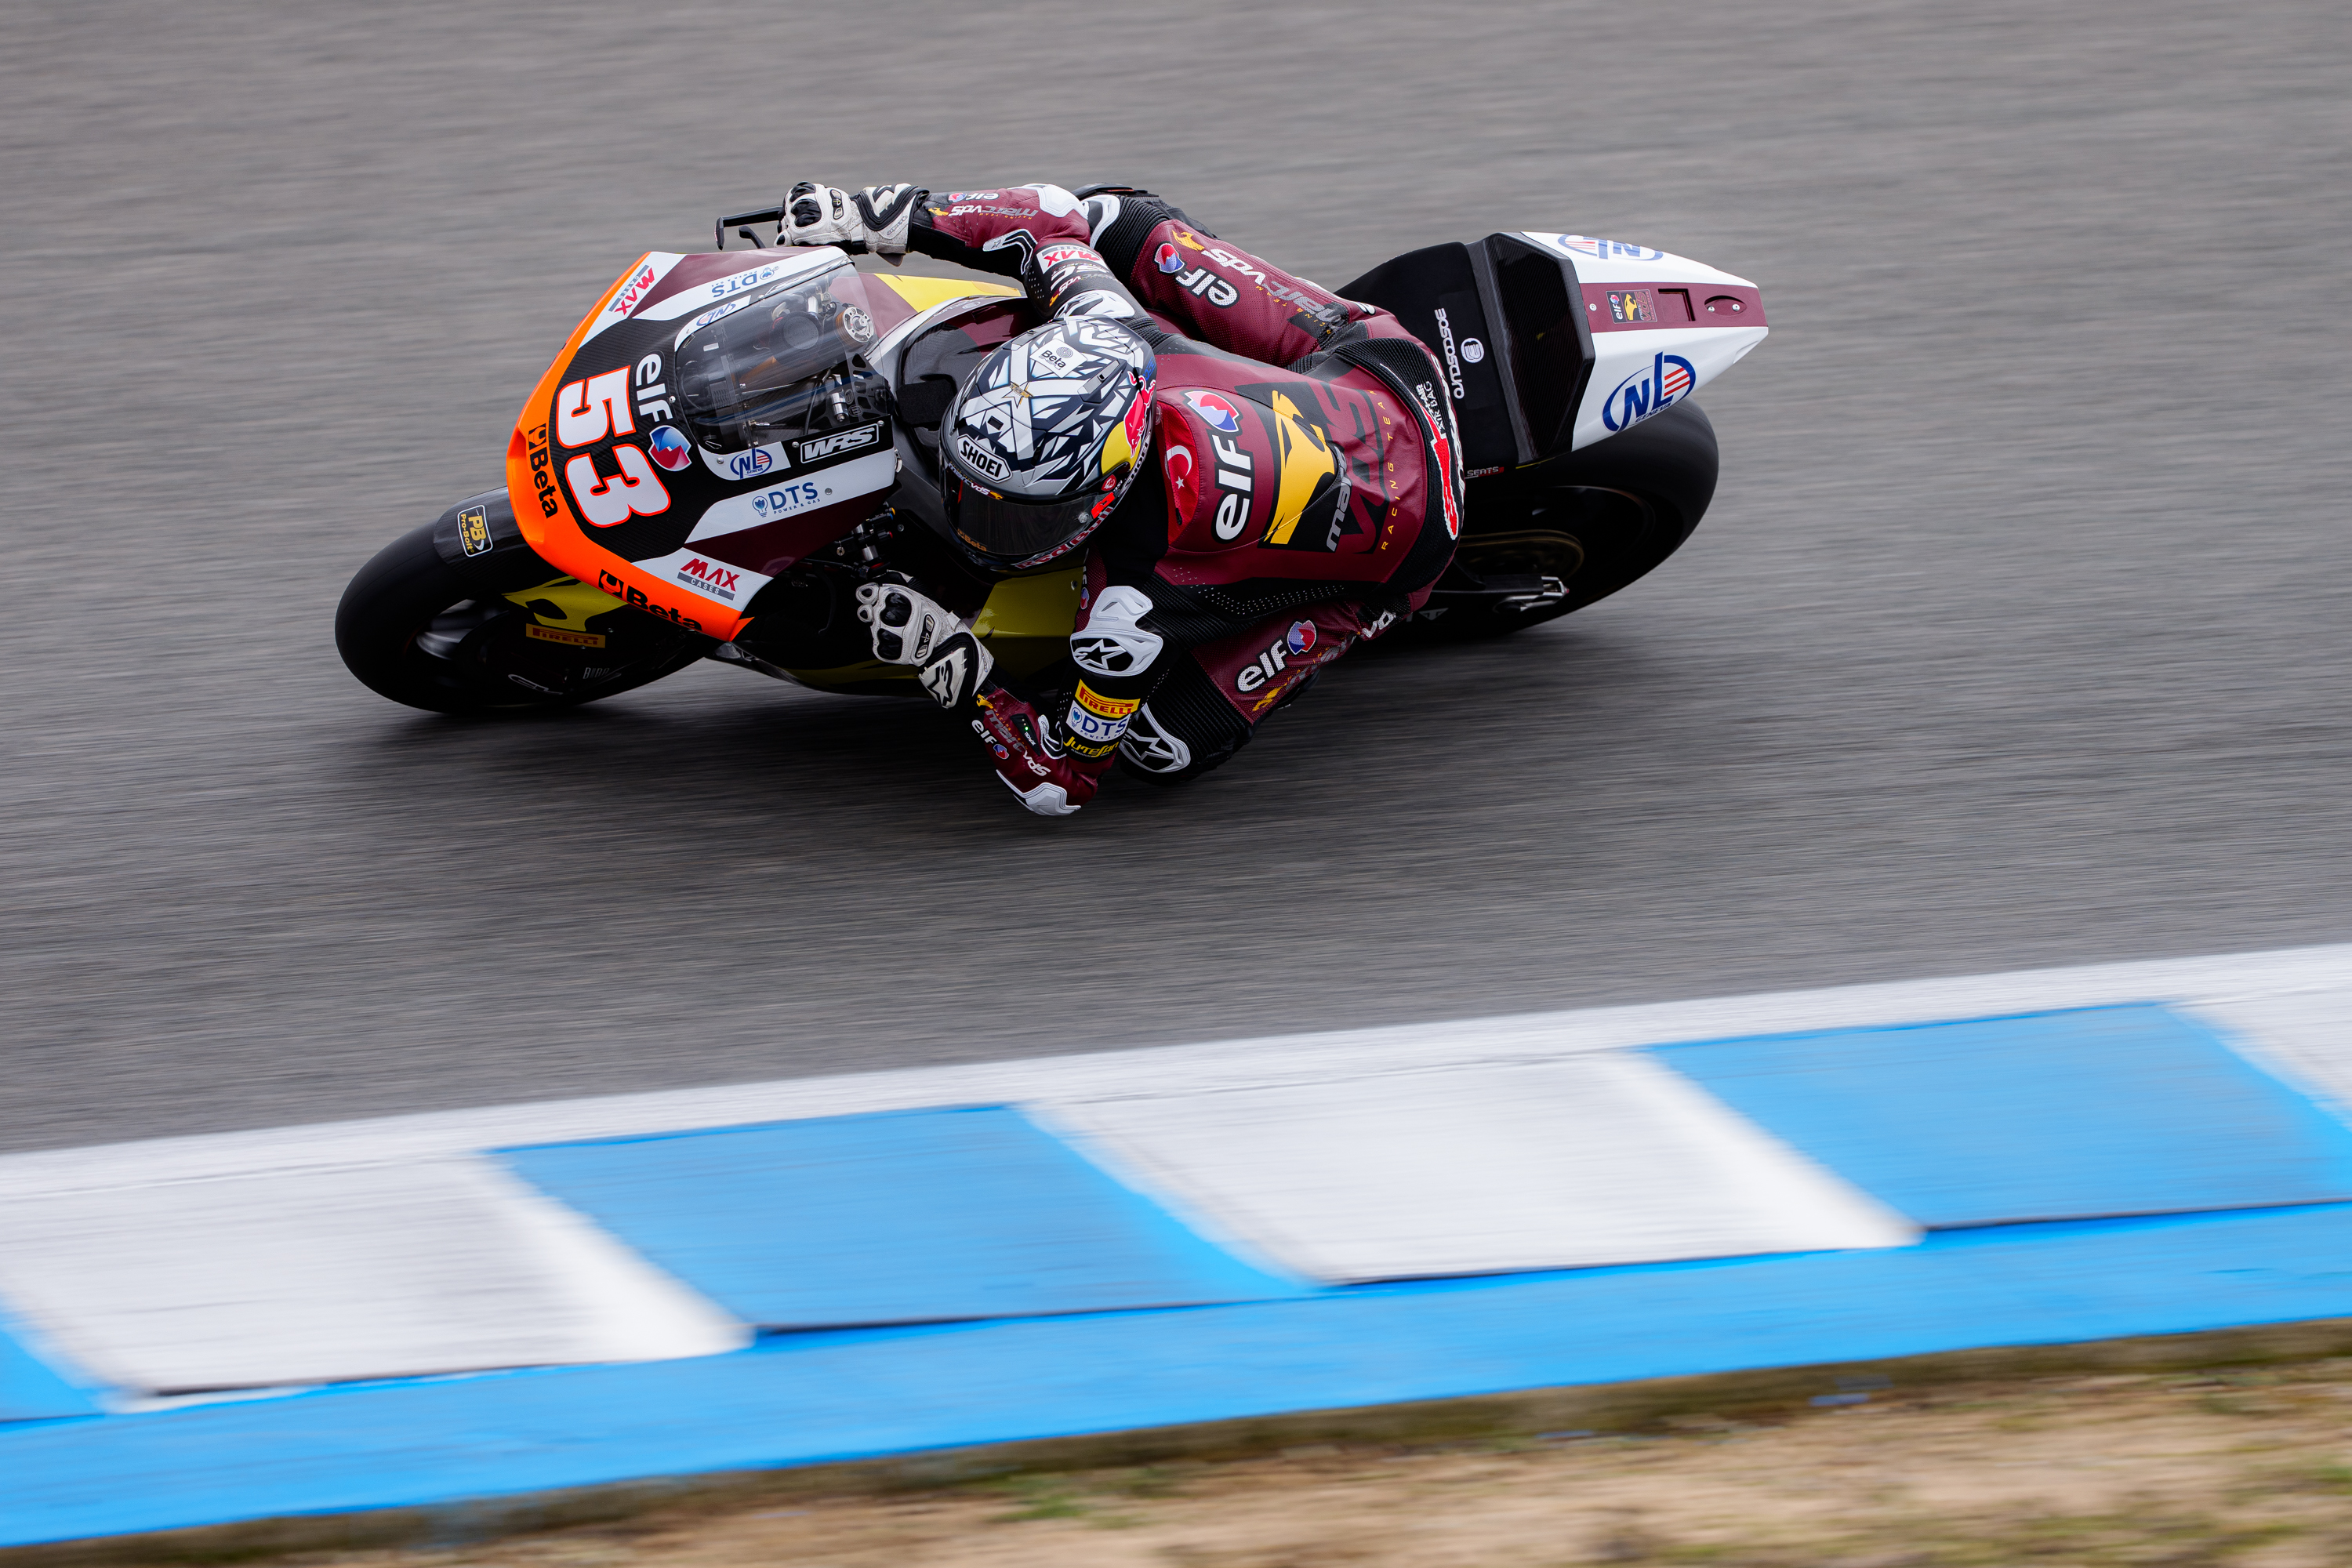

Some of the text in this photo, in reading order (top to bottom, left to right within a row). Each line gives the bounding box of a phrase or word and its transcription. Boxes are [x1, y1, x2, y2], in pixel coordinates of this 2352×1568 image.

[1044, 250, 1101, 268] MAX
[614, 267, 655, 316] MAX
[711, 271, 758, 298] DTS
[1175, 268, 1238, 306] elf
[1613, 303, 1623, 320] elf
[1041, 350, 1066, 368] Beta
[636, 353, 673, 423] elf
[1423, 380, 1439, 408] BAG
[1635, 401, 1671, 423] GENEVA
[556, 365, 671, 528] 53
[804, 427, 876, 460] WRS
[960, 440, 1004, 477] SHOEI
[1466, 466, 1500, 477] SEATS
[529, 446, 558, 520] Beta
[768, 481, 819, 510] DTS
[1211, 434, 1252, 540] elf
[773, 506, 798, 515] POWER
[1381, 462, 1401, 550] RACING
[468, 515, 487, 541] PB
[1014, 543, 1071, 570] Red
[680, 557, 741, 593] MAX
[690, 577, 720, 594] CASES
[626, 585, 703, 632] Beta
[532, 627, 599, 646] PIRELLI
[1237, 639, 1287, 692] elf
[1079, 686, 1134, 715] PIRELLI
[971, 720, 997, 745] elf
[1081, 714, 1128, 736] DTS
